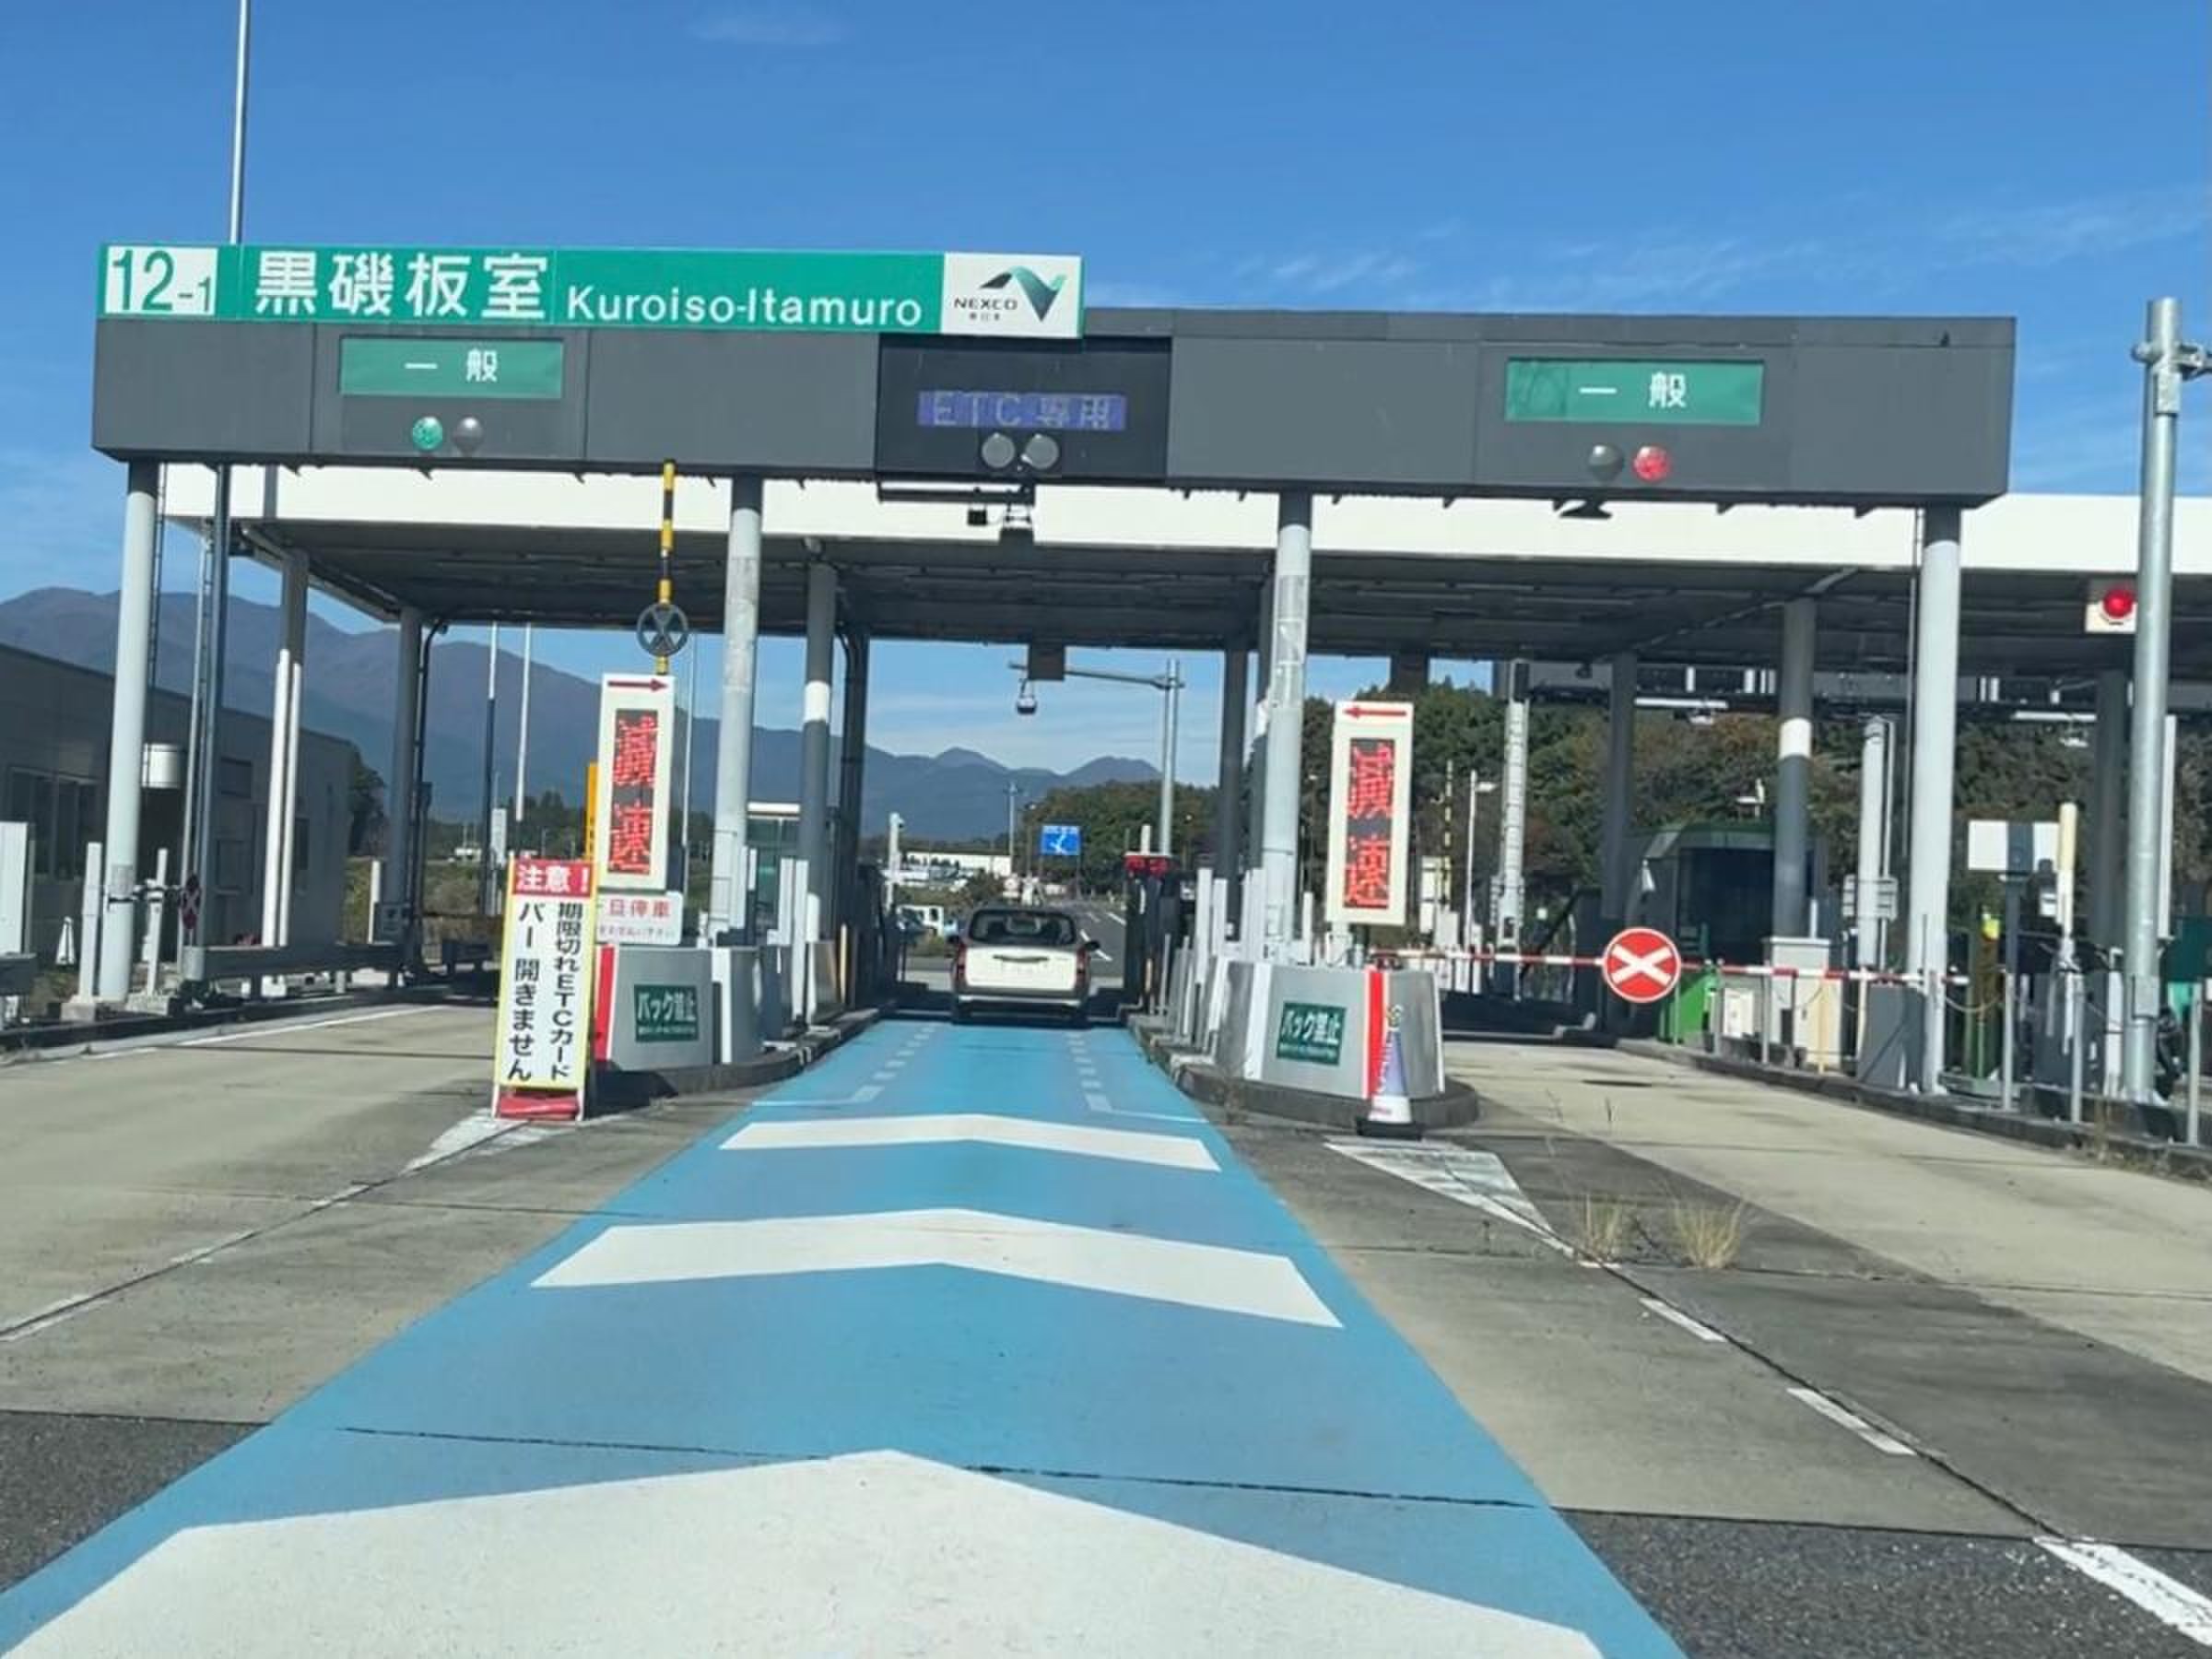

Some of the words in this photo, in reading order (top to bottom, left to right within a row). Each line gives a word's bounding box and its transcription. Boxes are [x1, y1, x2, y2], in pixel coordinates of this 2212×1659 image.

[256, 251, 547, 319] 黒磯板室
[954, 298, 1018, 311] NEXCO
[568, 285, 923, 327] Kuroiso-Itamuro
[405, 348, 499, 382] 一般
[1579, 371, 1686, 408] 一般
[933, 391, 1112, 430] ETC専用
[550, 902, 583, 1081] 期限切れETCカード
